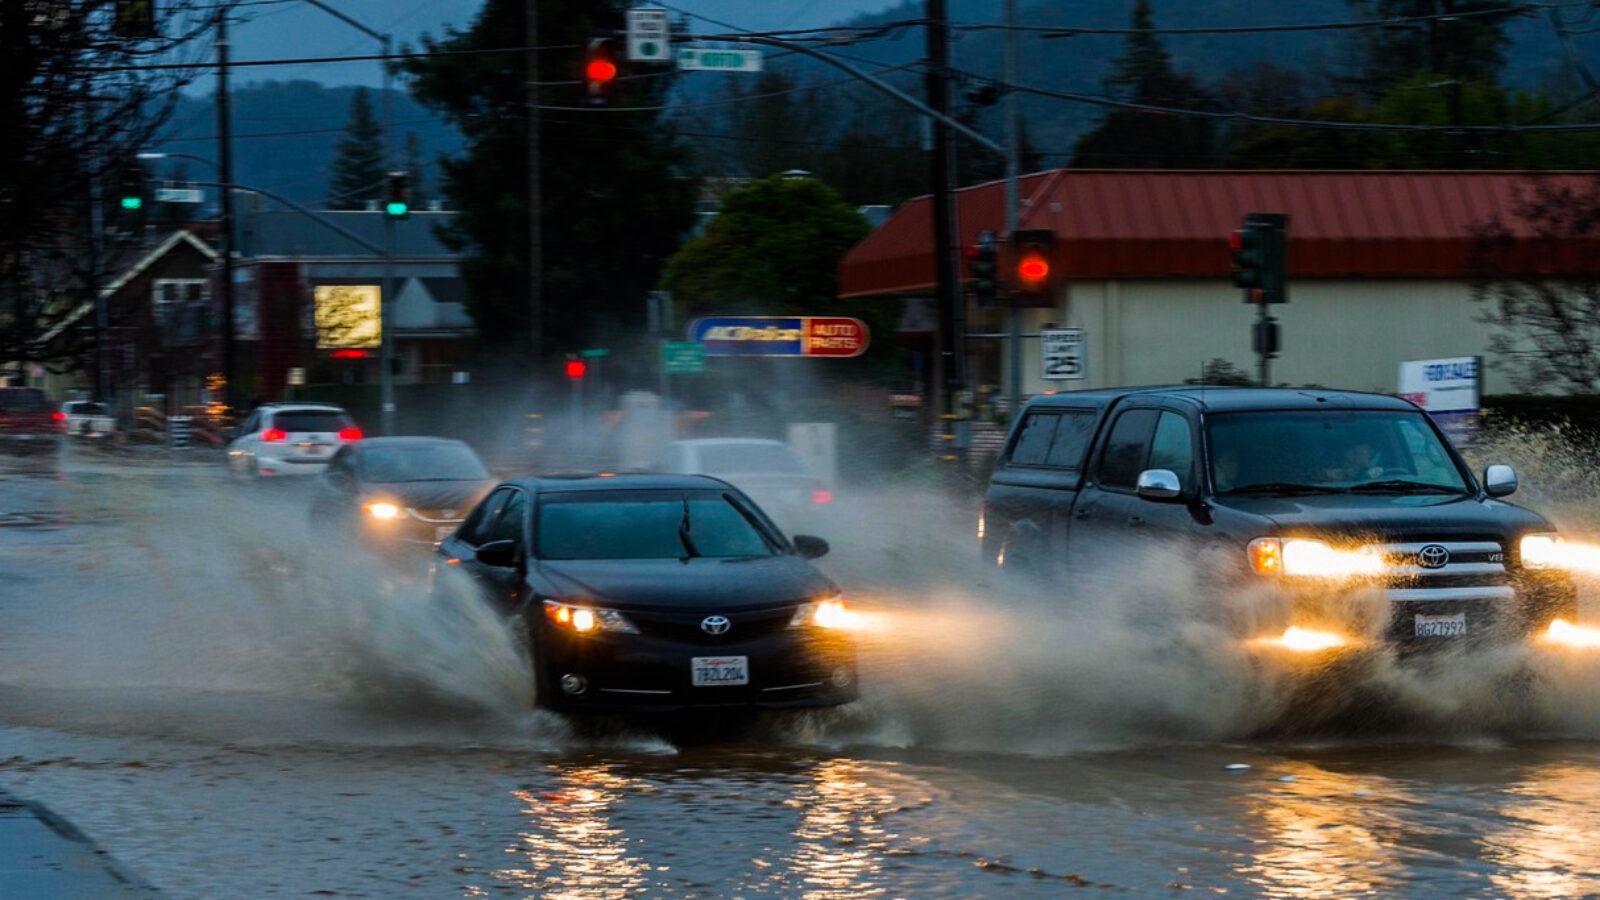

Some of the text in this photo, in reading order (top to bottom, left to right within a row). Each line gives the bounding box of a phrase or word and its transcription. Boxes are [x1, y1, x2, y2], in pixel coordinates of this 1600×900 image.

[813, 325, 858, 336] AUTO
[810, 337, 859, 348] PARTS
[1043, 334, 1081, 342] SPEED
[1045, 356, 1082, 374] 25
